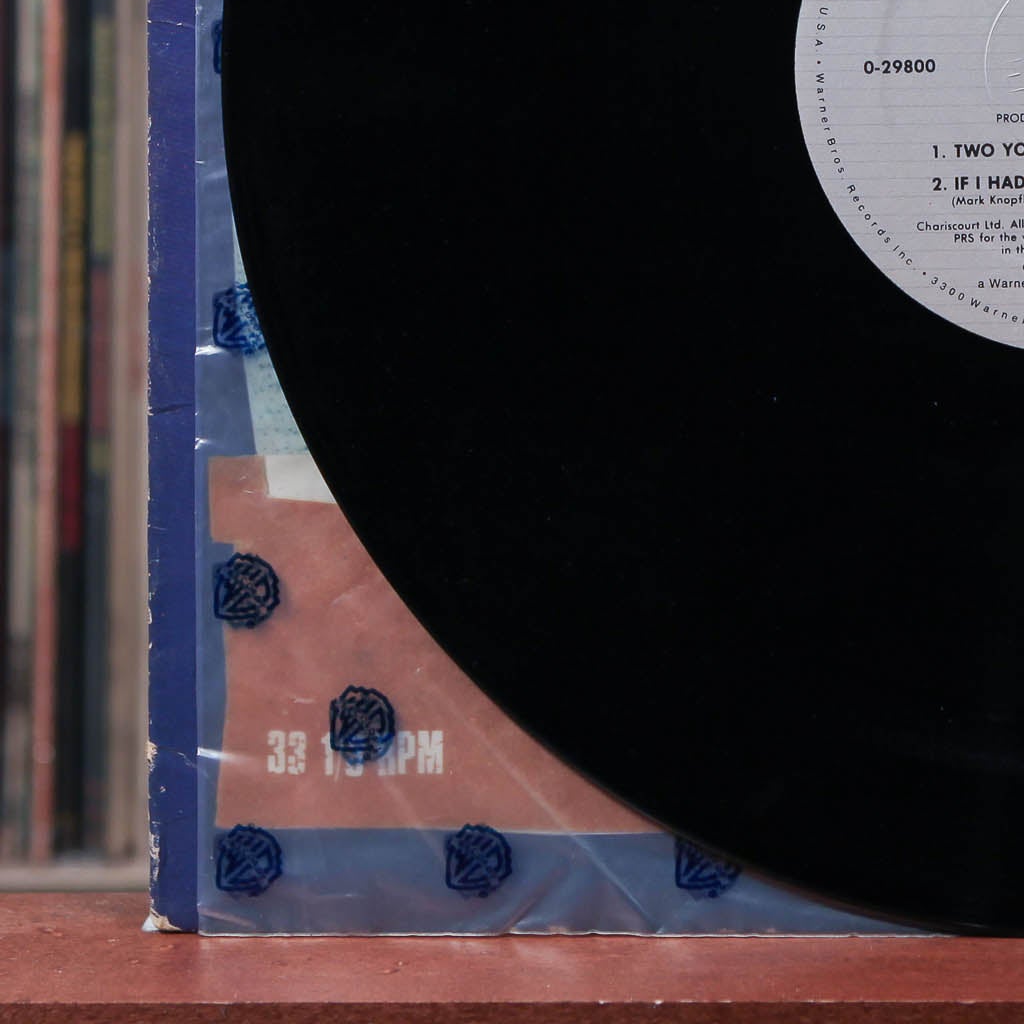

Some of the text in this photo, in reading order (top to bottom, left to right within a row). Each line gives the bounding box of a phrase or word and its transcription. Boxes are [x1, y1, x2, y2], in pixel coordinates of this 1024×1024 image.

[932, 144, 946, 159] 1.
[953, 142, 995, 159] TWO
[815, 72, 831, 131] Warner
[846, 184, 891, 244] Records
[930, 276, 965, 301] 3300
[931, 176, 948, 192] 2.
[954, 175, 969, 191] IF
[975, 175, 981, 190] I
[951, 194, 985, 208] (Mark
[916, 220, 980, 232] Chariscourt
[1009, 218, 1024, 229] All
[953, 232, 975, 244] PRS
[979, 231, 995, 243] for
[999, 231, 1018, 242] the
[1001, 244, 1012, 255] in
[977, 280, 985, 289] a
[267, 730, 307, 775] 33
